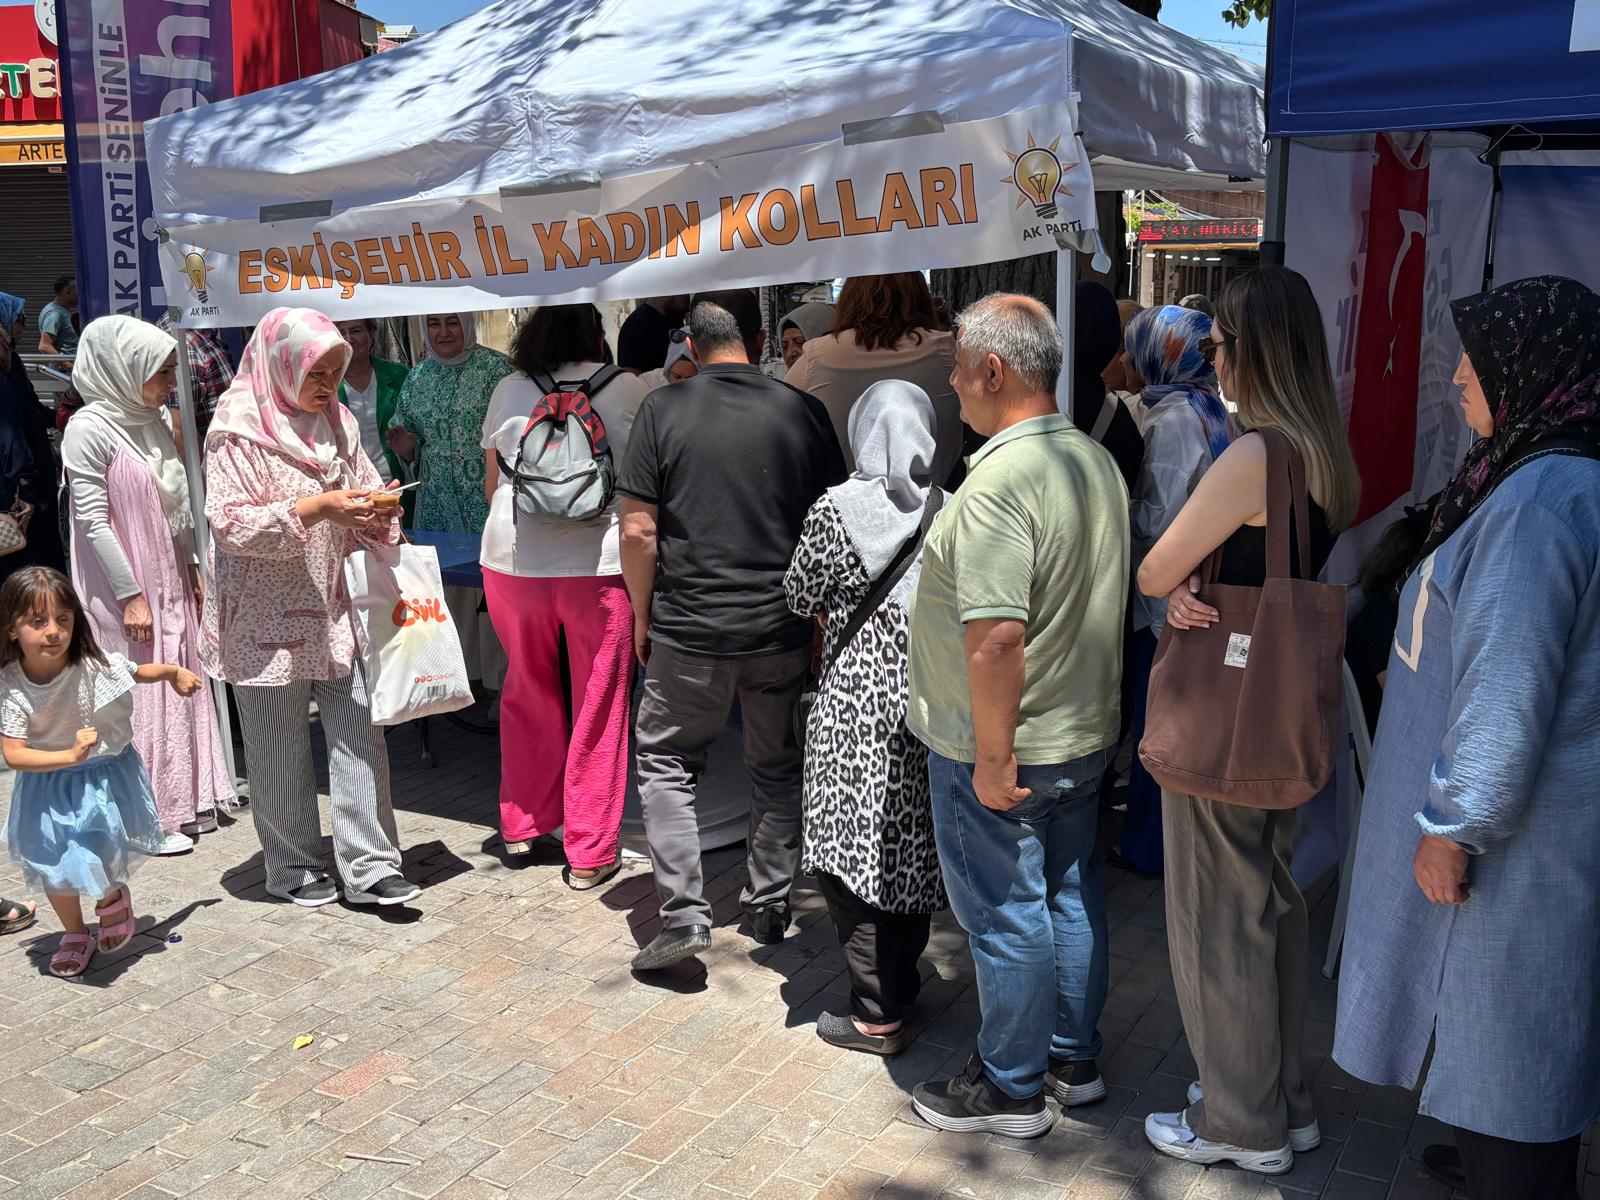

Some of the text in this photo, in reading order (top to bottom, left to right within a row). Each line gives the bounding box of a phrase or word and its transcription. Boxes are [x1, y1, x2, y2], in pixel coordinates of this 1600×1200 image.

[238, 163, 978, 299] ESKİŞEHİR İL KADIN KOLLARI
[1023, 226, 1042, 241] AK
[190, 307, 200, 316] AK
